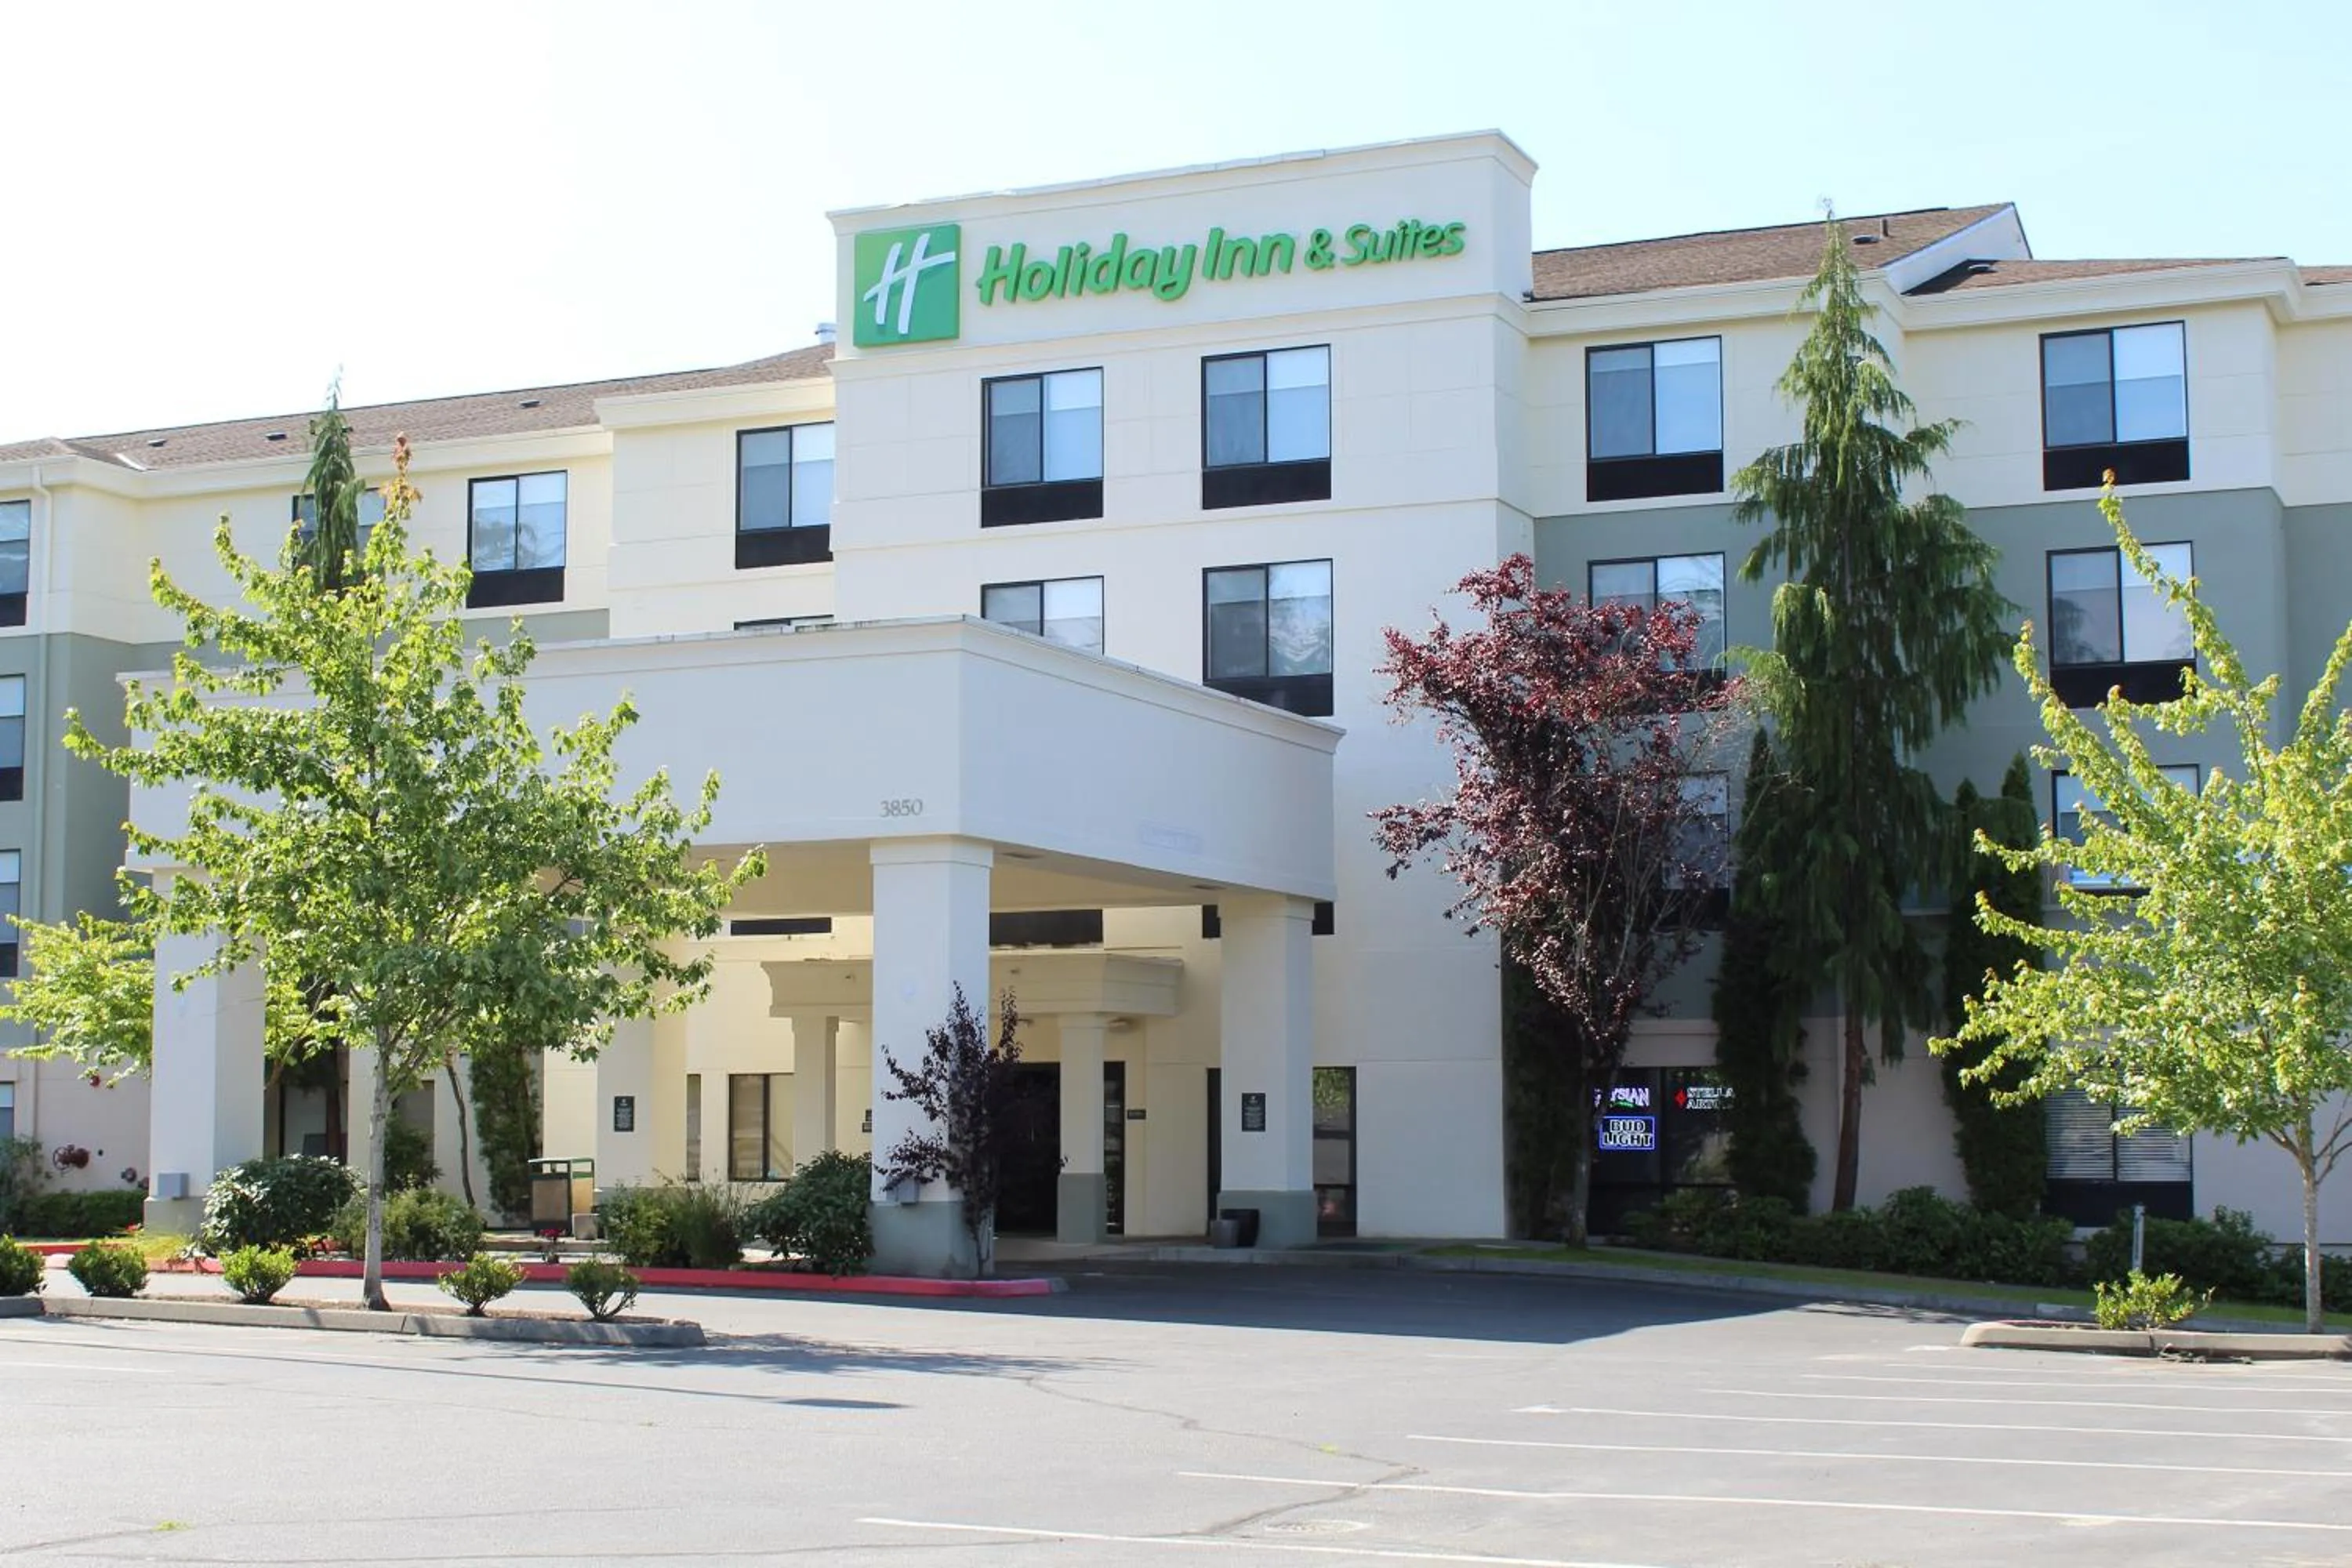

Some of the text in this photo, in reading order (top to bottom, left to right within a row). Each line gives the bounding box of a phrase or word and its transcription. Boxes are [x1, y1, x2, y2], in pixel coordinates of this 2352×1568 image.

[976, 219, 1467, 307] Holiday Inn & Suites
[879, 798, 924, 818] 3850
[1686, 1087, 1736, 1098] STELLA
[1610, 1119, 1646, 1133] BUD
[1602, 1132, 1653, 1147] LIGHT
